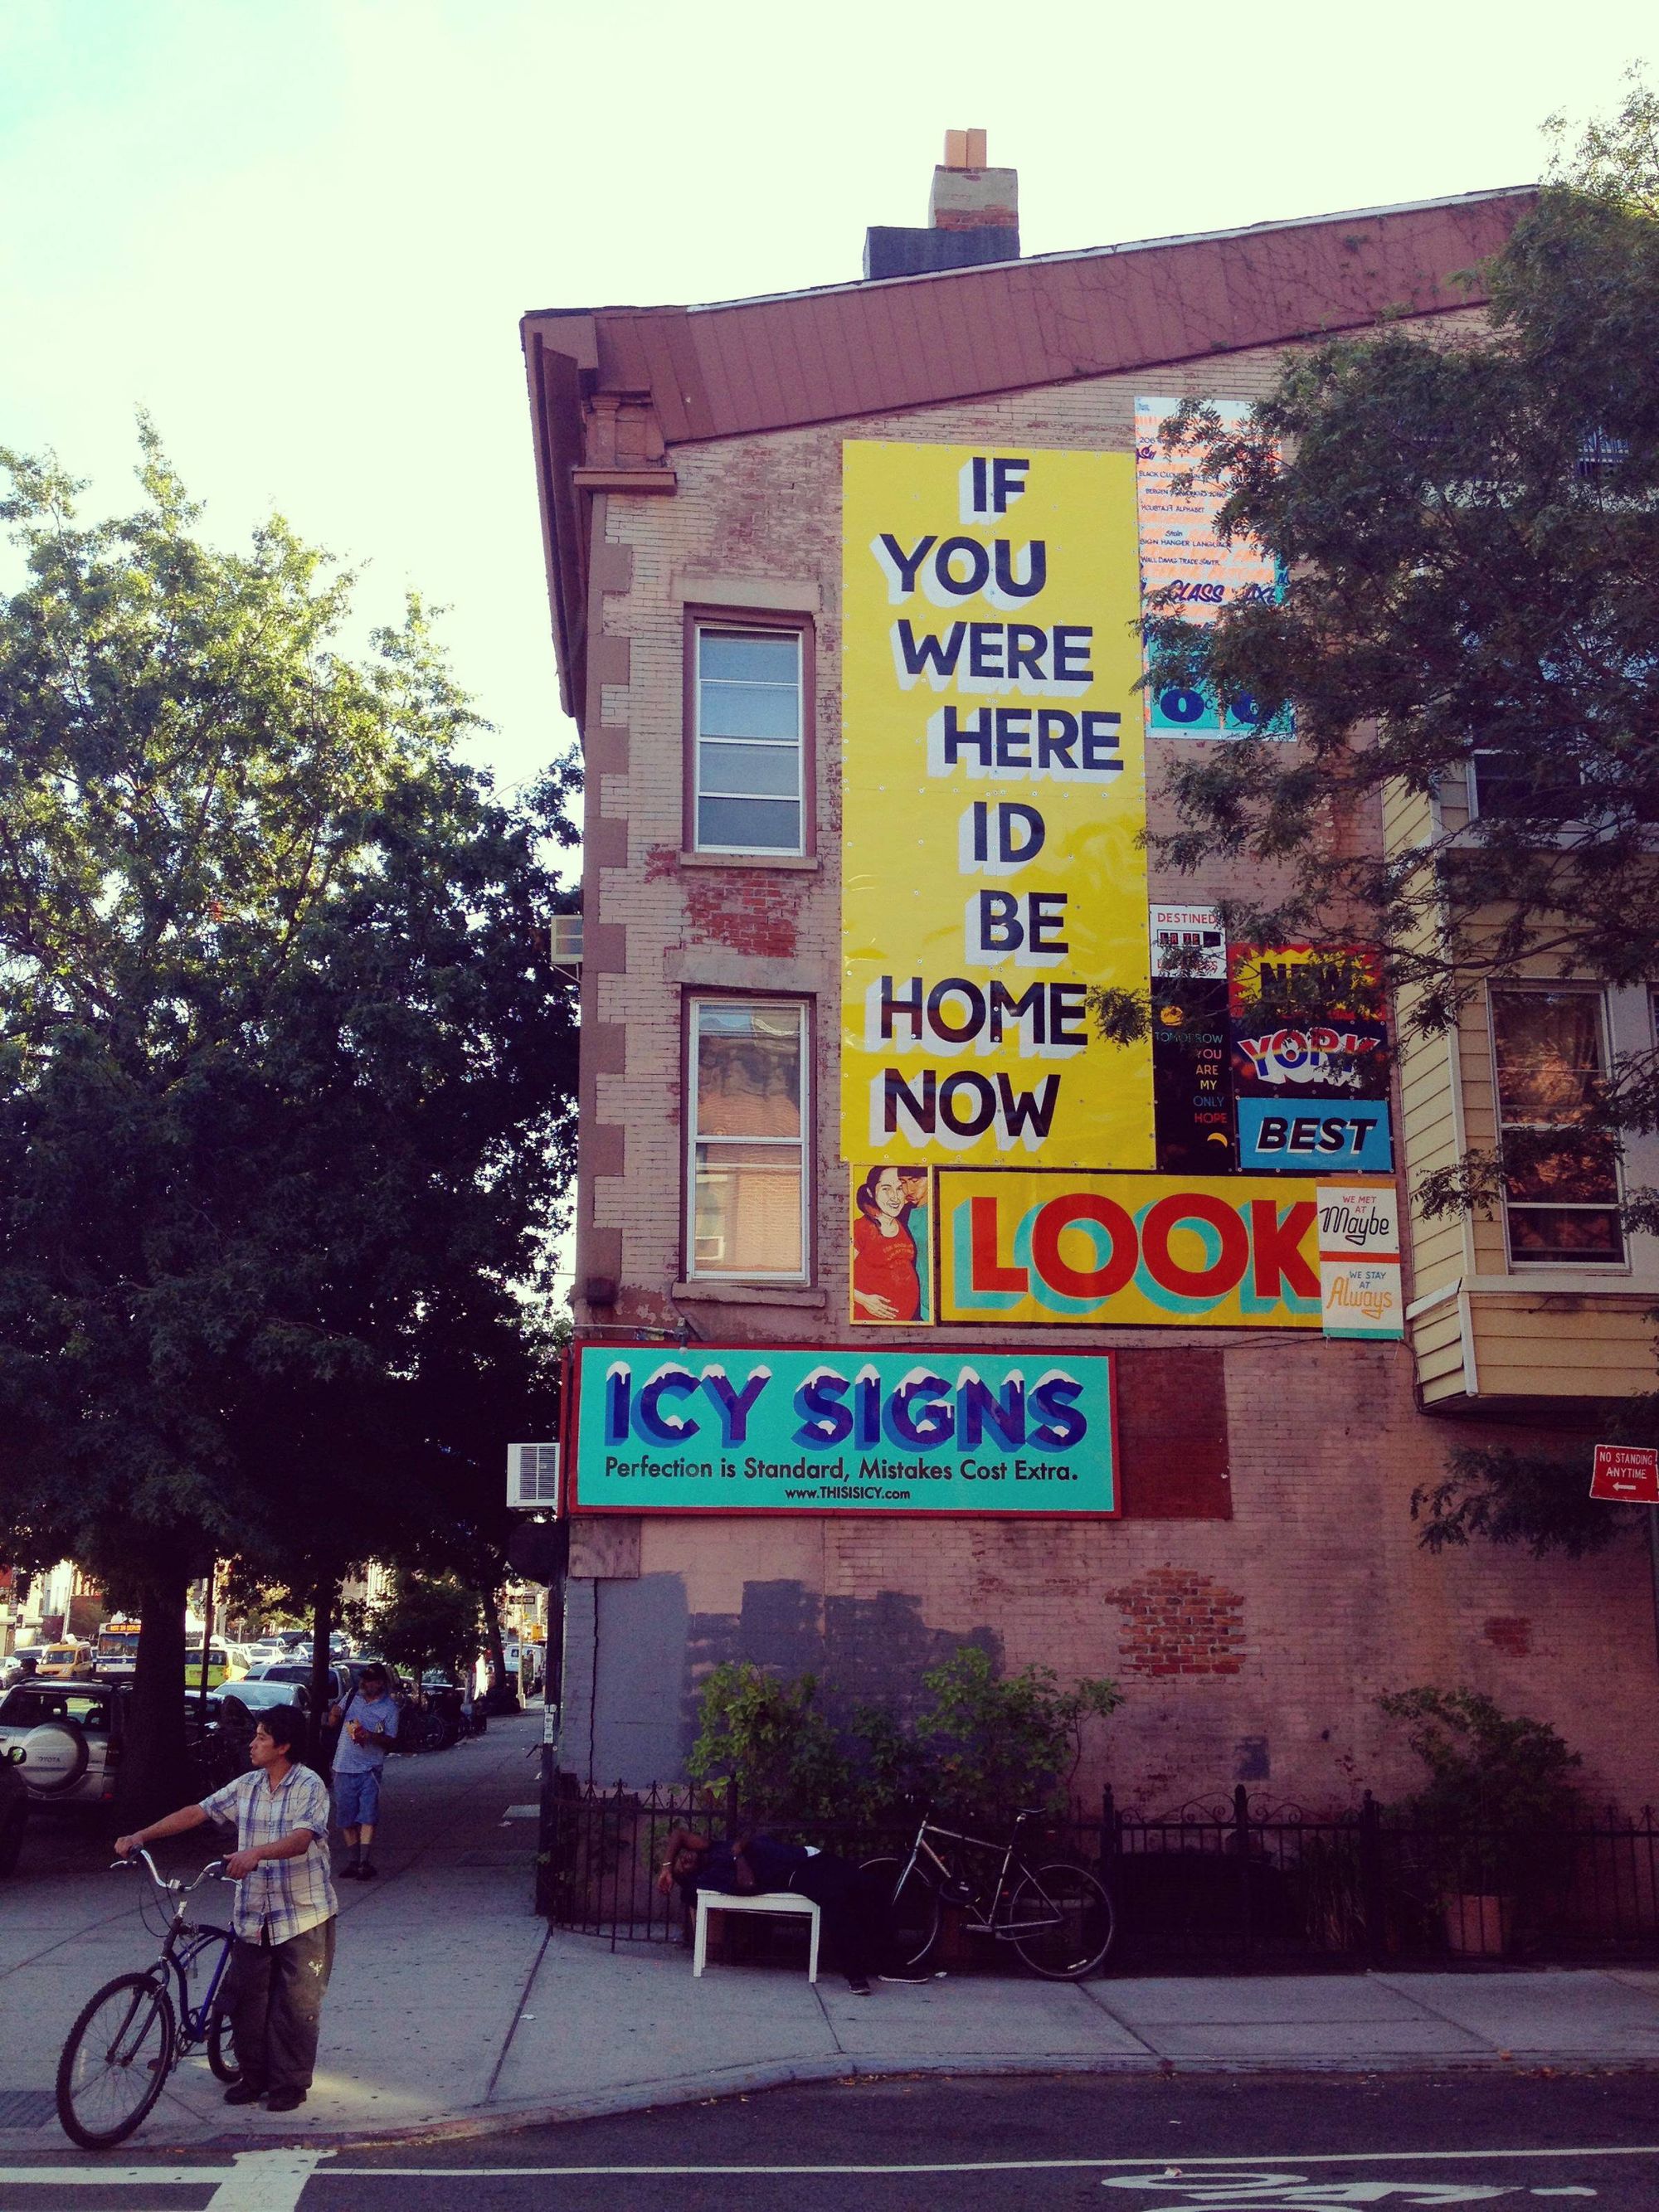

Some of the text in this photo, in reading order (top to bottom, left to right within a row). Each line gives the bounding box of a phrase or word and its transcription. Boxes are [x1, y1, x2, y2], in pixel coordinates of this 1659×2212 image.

[961, 457, 1030, 524] IF
[871, 533, 1047, 609] YOU
[891, 619, 1094, 695] WERE
[929, 706, 1125, 781] HERE
[961, 801, 1046, 874] ID
[968, 889, 1069, 965] BE
[1157, 912, 1218, 925] DESTINED
[866, 975, 1088, 1057] HOME
[1195, 1064, 1219, 1076] ARE
[1199, 1080, 1218, 1091] MY
[871, 1068, 1062, 1150] NOW
[1193, 1096, 1225, 1107] ONLY
[1194, 1112, 1228, 1124] HOPE
[1255, 1116, 1379, 1155] BEST
[1354, 1206, 1367, 1214] AT
[1357, 1196, 1377, 1204] MET
[1319, 1206, 1389, 1246] Maybe
[956, 1193, 1321, 1313] LOOK
[1349, 1271, 1387, 1280] WE STAY
[1359, 1281, 1371, 1290] AT
[1326, 1276, 1394, 1320] Always
[604, 1361, 1088, 1453] ICY SIGNS
[605, 1455, 1078, 1483] Perfection is Standard, Mistakes Cost Extra.
[1599, 1451, 1653, 1466] NO STANDING
[1606, 1466, 1647, 1480] ANYTIME
[785, 1485, 911, 1500] www.THISISICY.com
